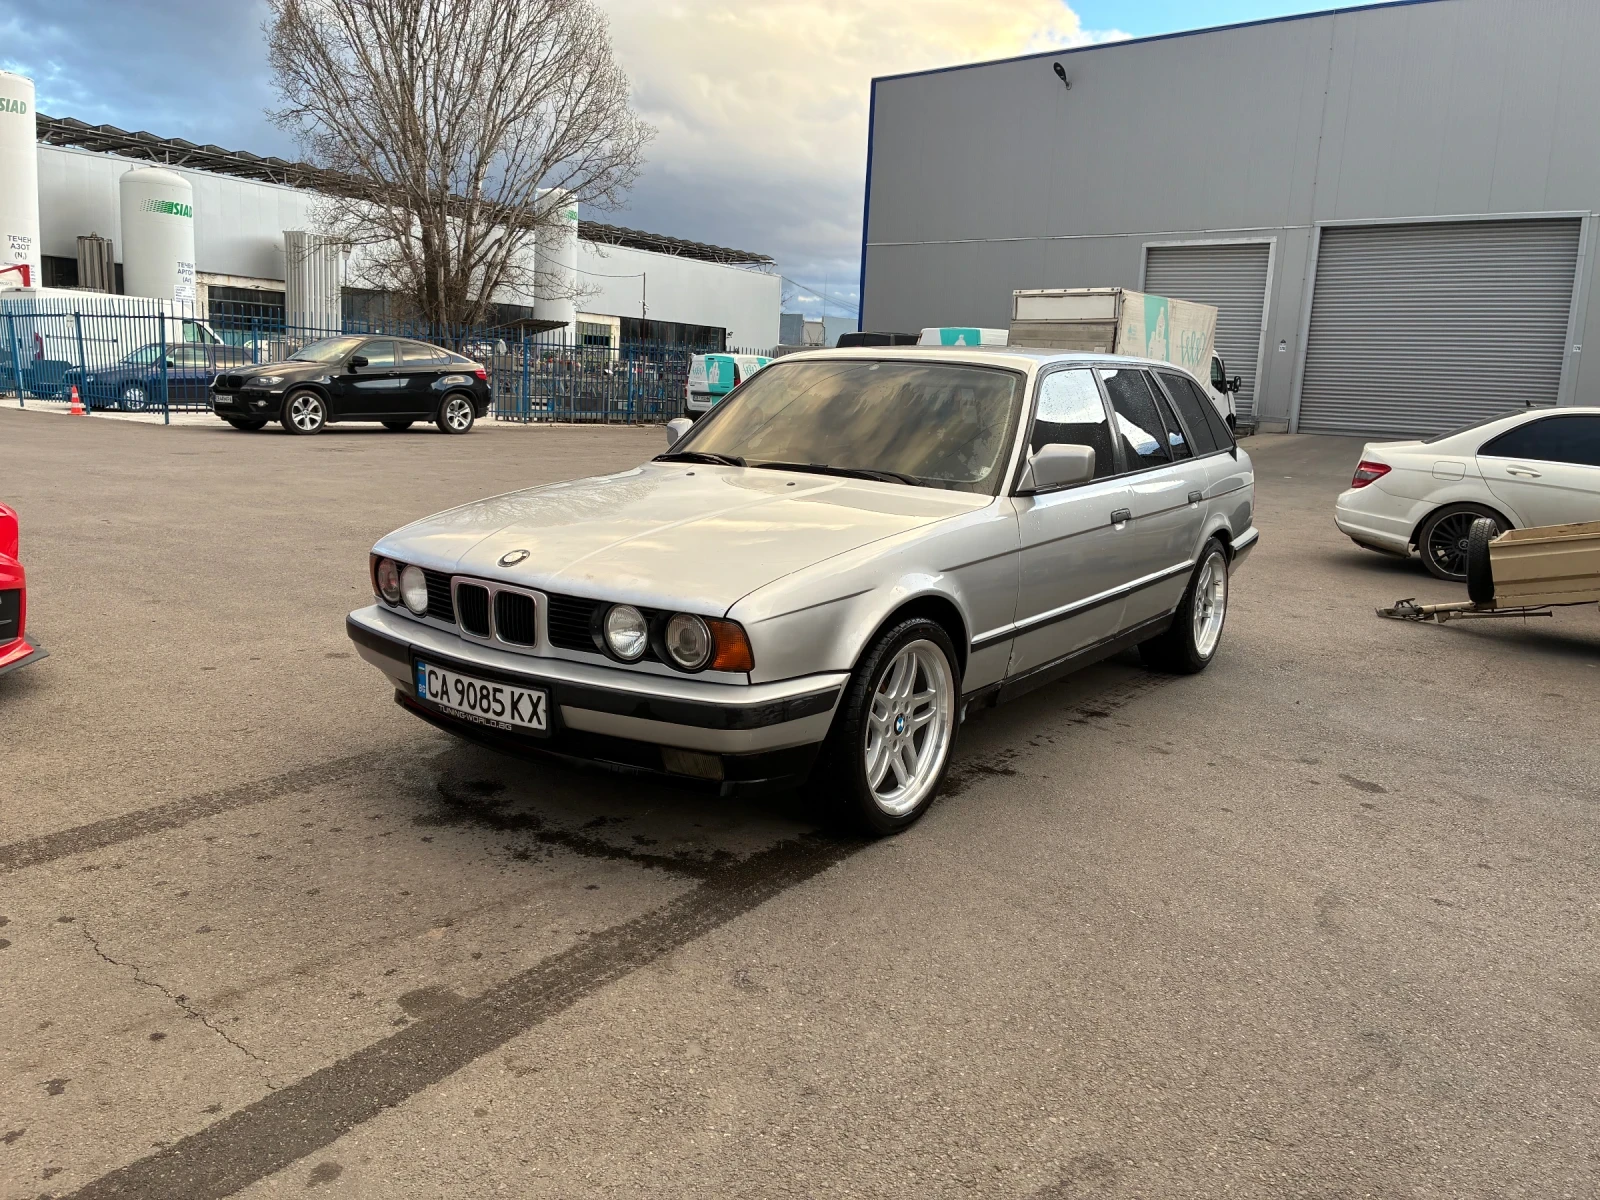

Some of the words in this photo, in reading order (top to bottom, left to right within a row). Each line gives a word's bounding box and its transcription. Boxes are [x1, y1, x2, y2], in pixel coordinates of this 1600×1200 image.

[0, 97, 27, 115] SIAD
[173, 202, 193, 218] SIAD
[7, 234, 32, 244] ТЕЧЕН
[10, 242, 31, 251] АЗОТ
[418, 683, 426, 694] BG
[427, 669, 451, 704] CA
[454, 678, 506, 717] 9085
[510, 690, 543, 726] KX
